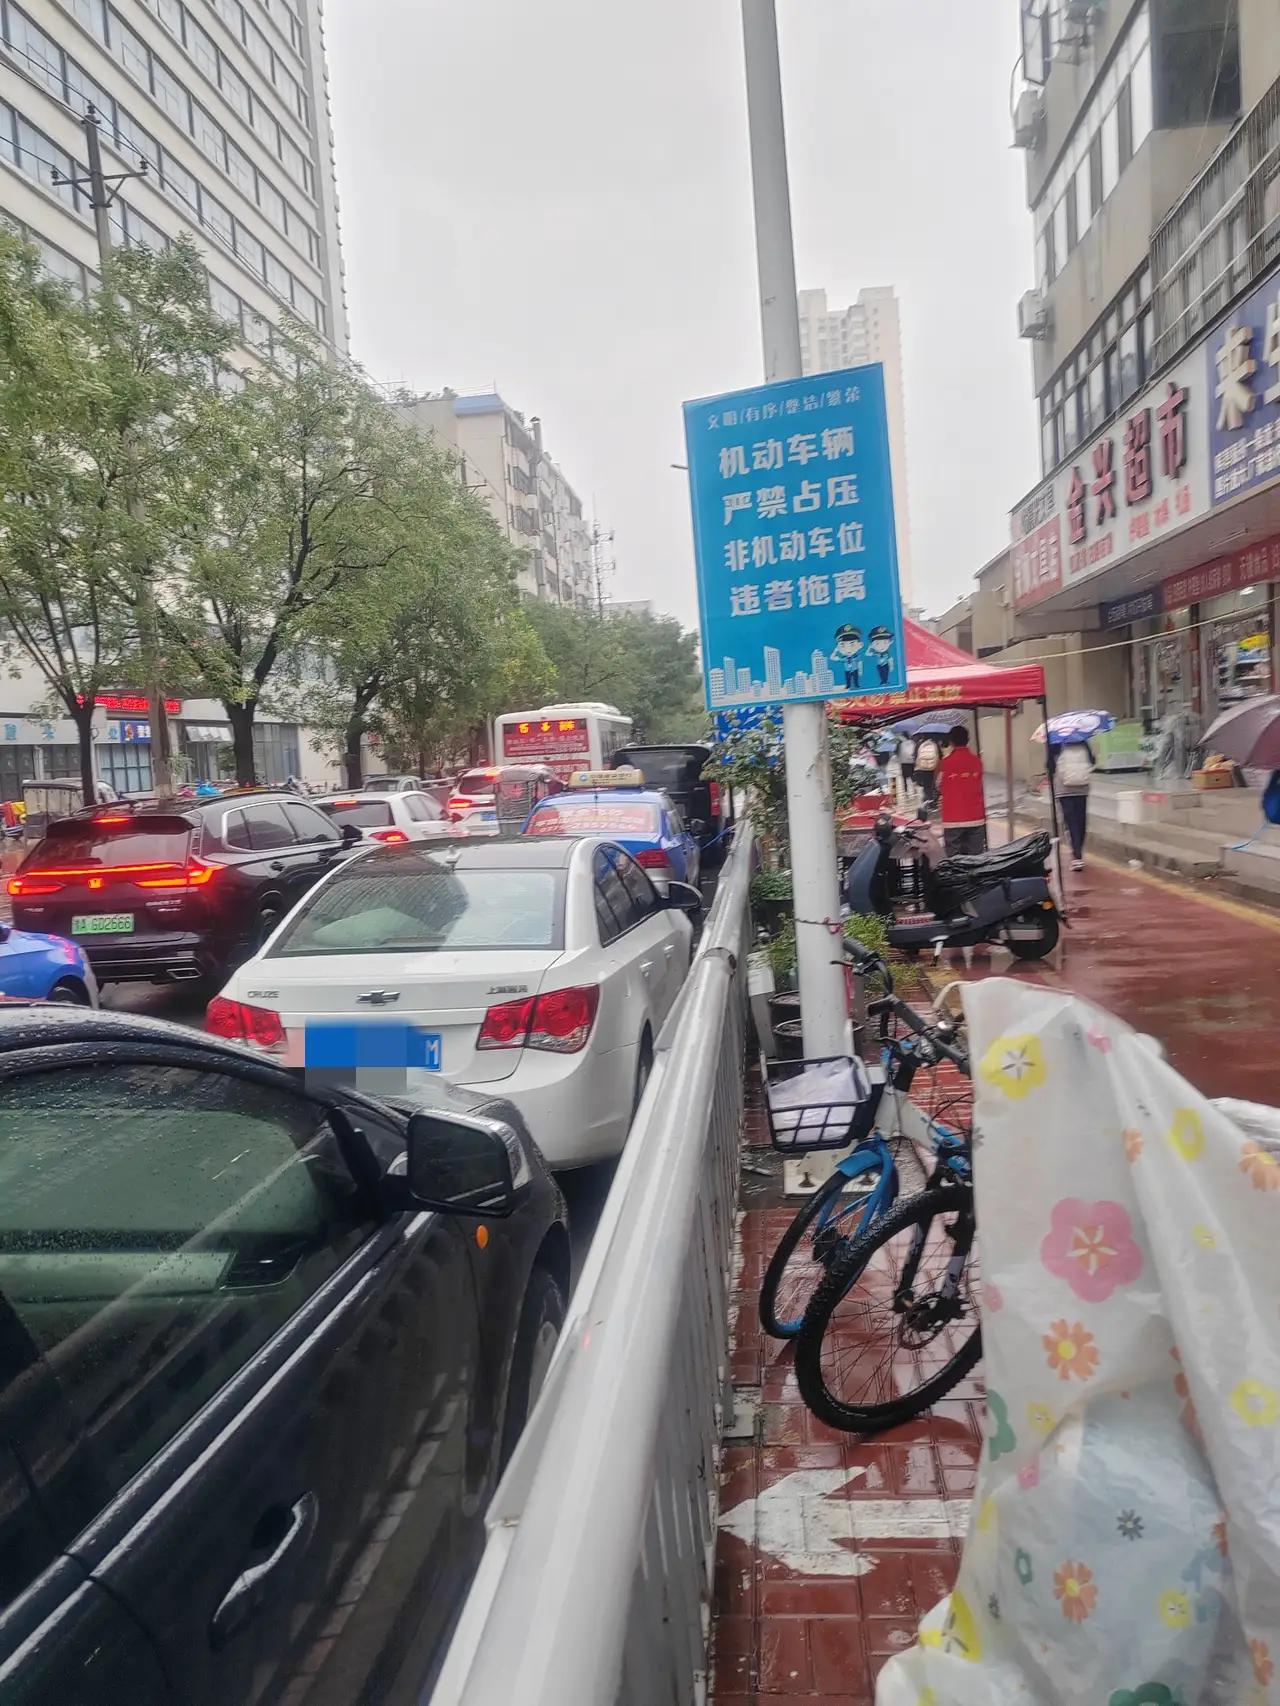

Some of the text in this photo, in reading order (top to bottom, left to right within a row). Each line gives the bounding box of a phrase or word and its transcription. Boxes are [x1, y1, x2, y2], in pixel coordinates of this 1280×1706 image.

[719, 426, 855, 479] 机动车辆
[721, 474, 859, 526] 严禁占压
[724, 522, 866, 572] 非机动车位
[730, 569, 866, 618] 违者拖离
